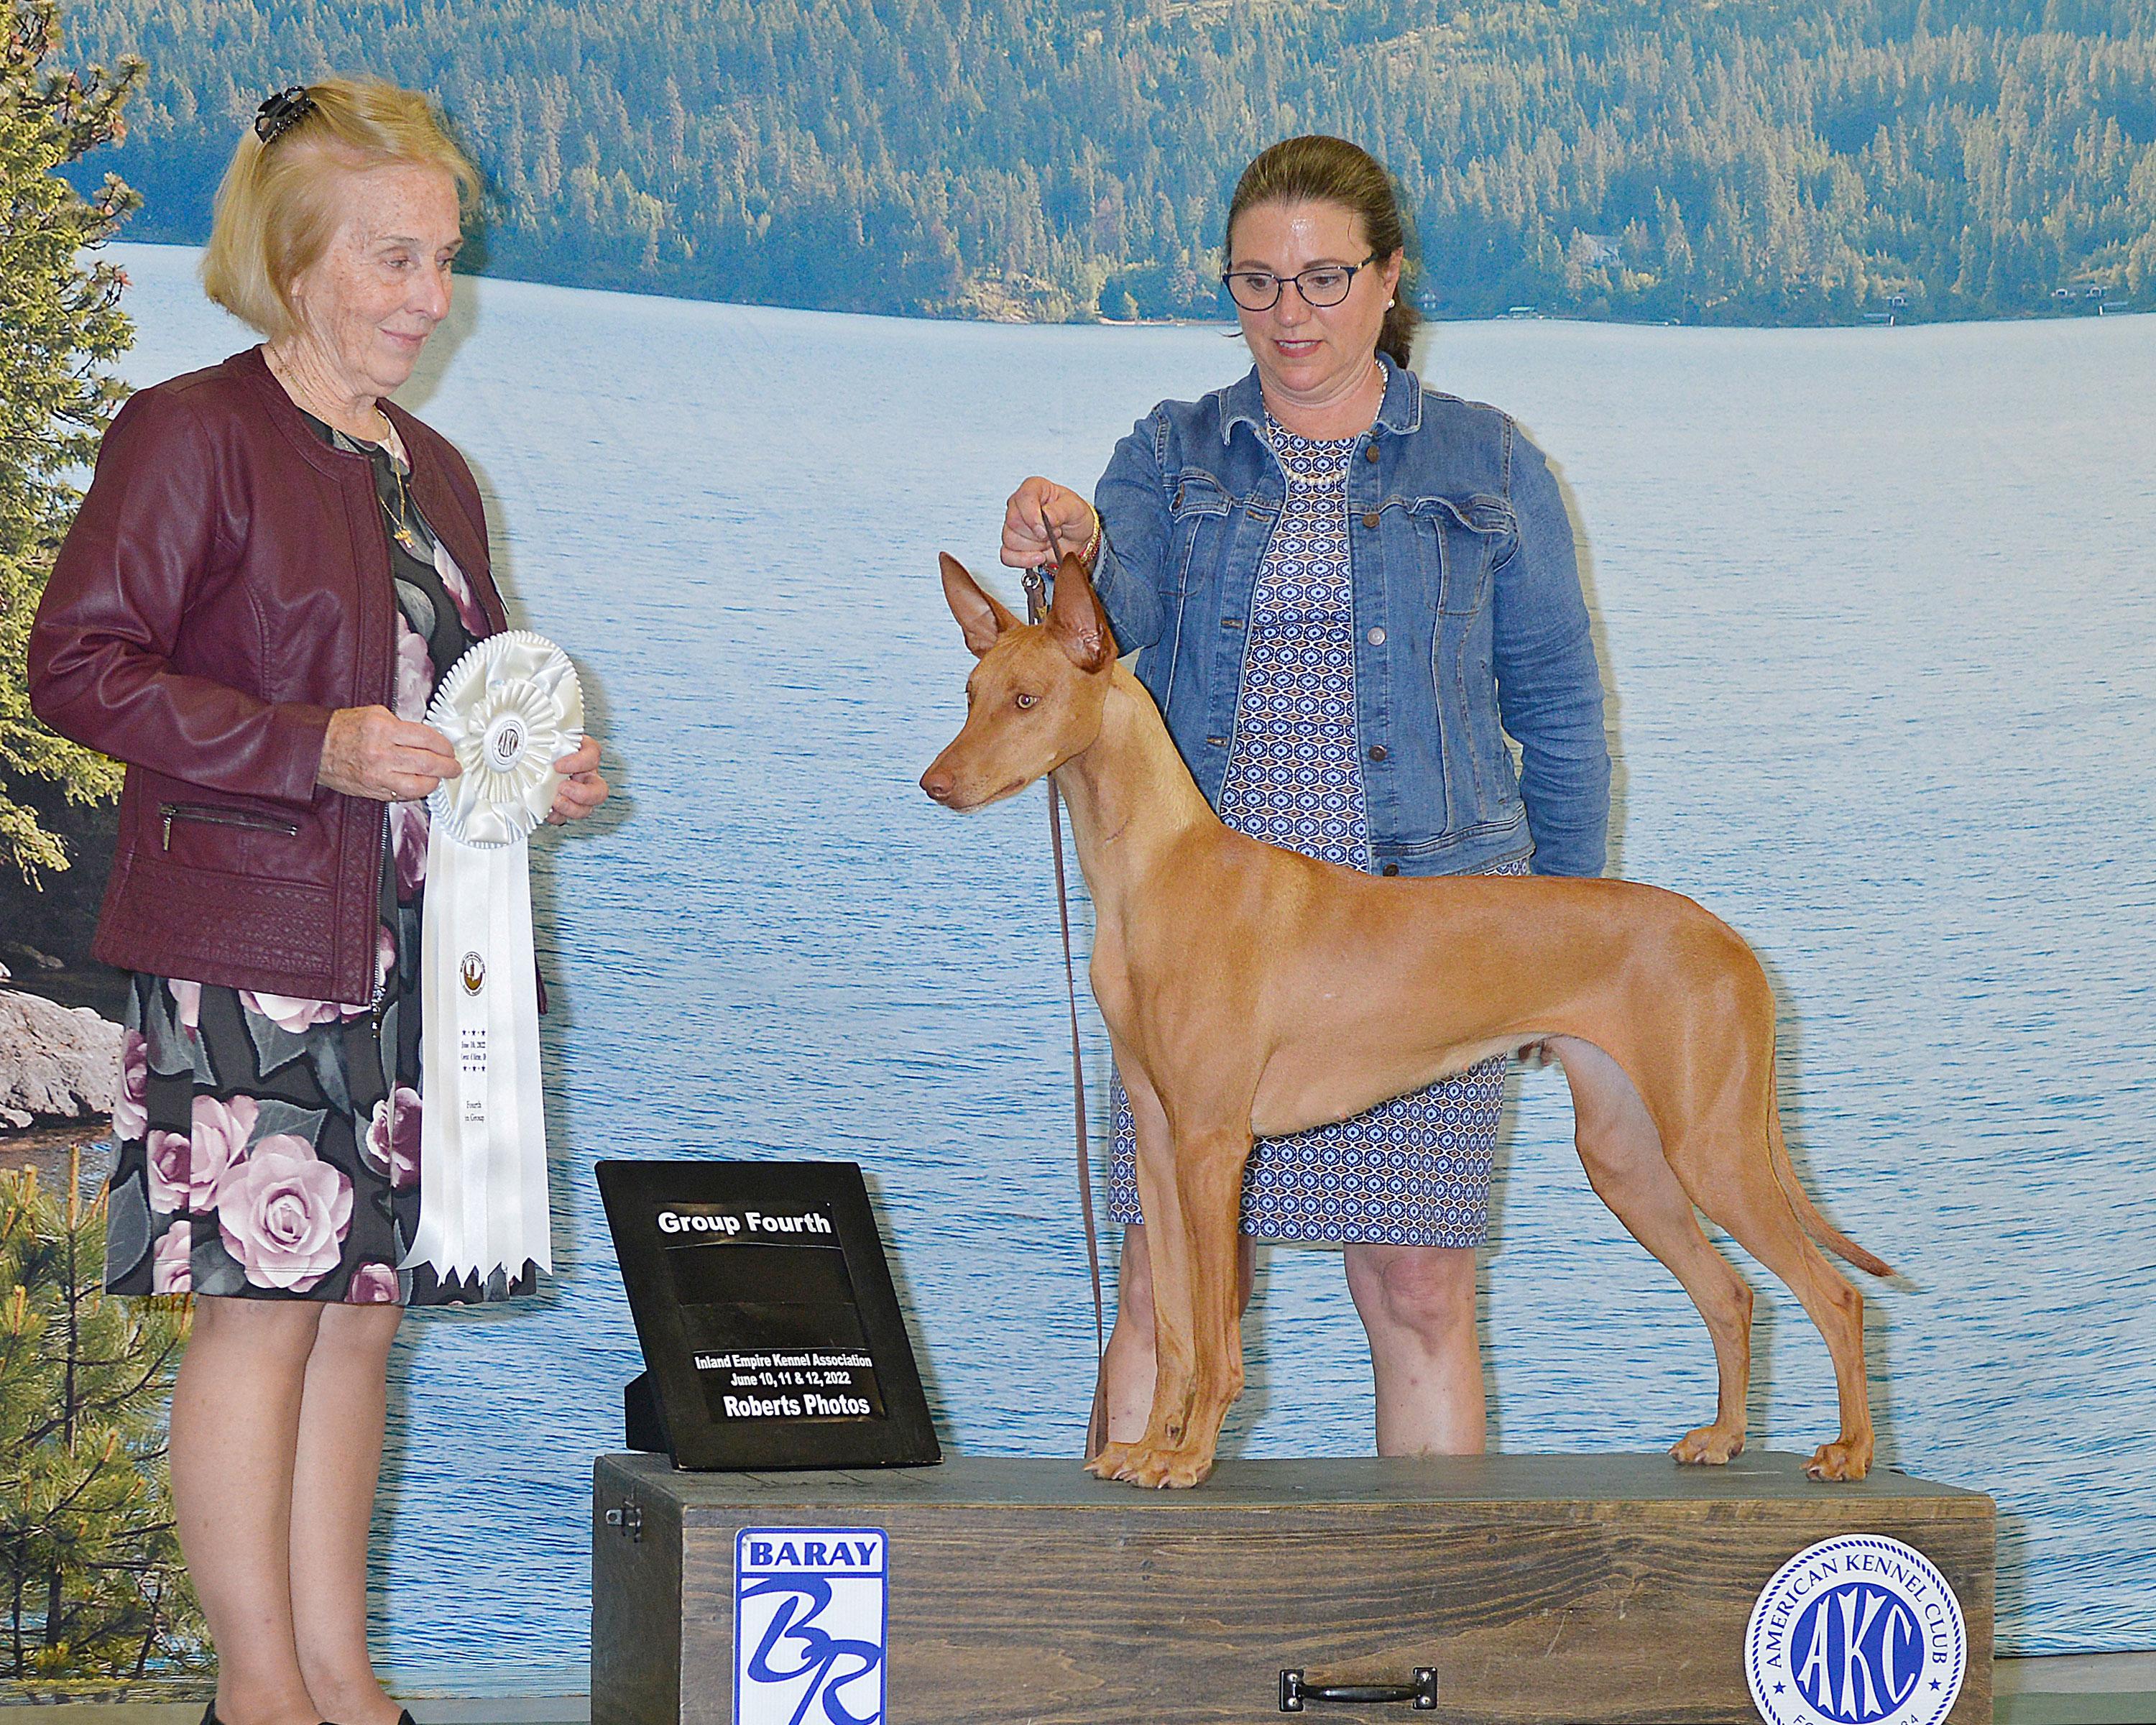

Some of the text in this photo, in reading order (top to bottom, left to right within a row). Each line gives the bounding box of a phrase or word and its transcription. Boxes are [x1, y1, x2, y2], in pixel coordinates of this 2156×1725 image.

[658, 1212, 832, 1236] Group Fourth
[694, 1353, 872, 1370] Inland Empire Kennel Association
[730, 1371, 852, 1388] June 10, 11 & 12, 2022
[723, 1394, 870, 1417] Roberts Photos
[750, 1542, 877, 1566] BARAY
[1766, 1554, 1948, 1669] AMERICAN KENNEL CLUB
[1797, 1586, 1916, 1722] AKC
